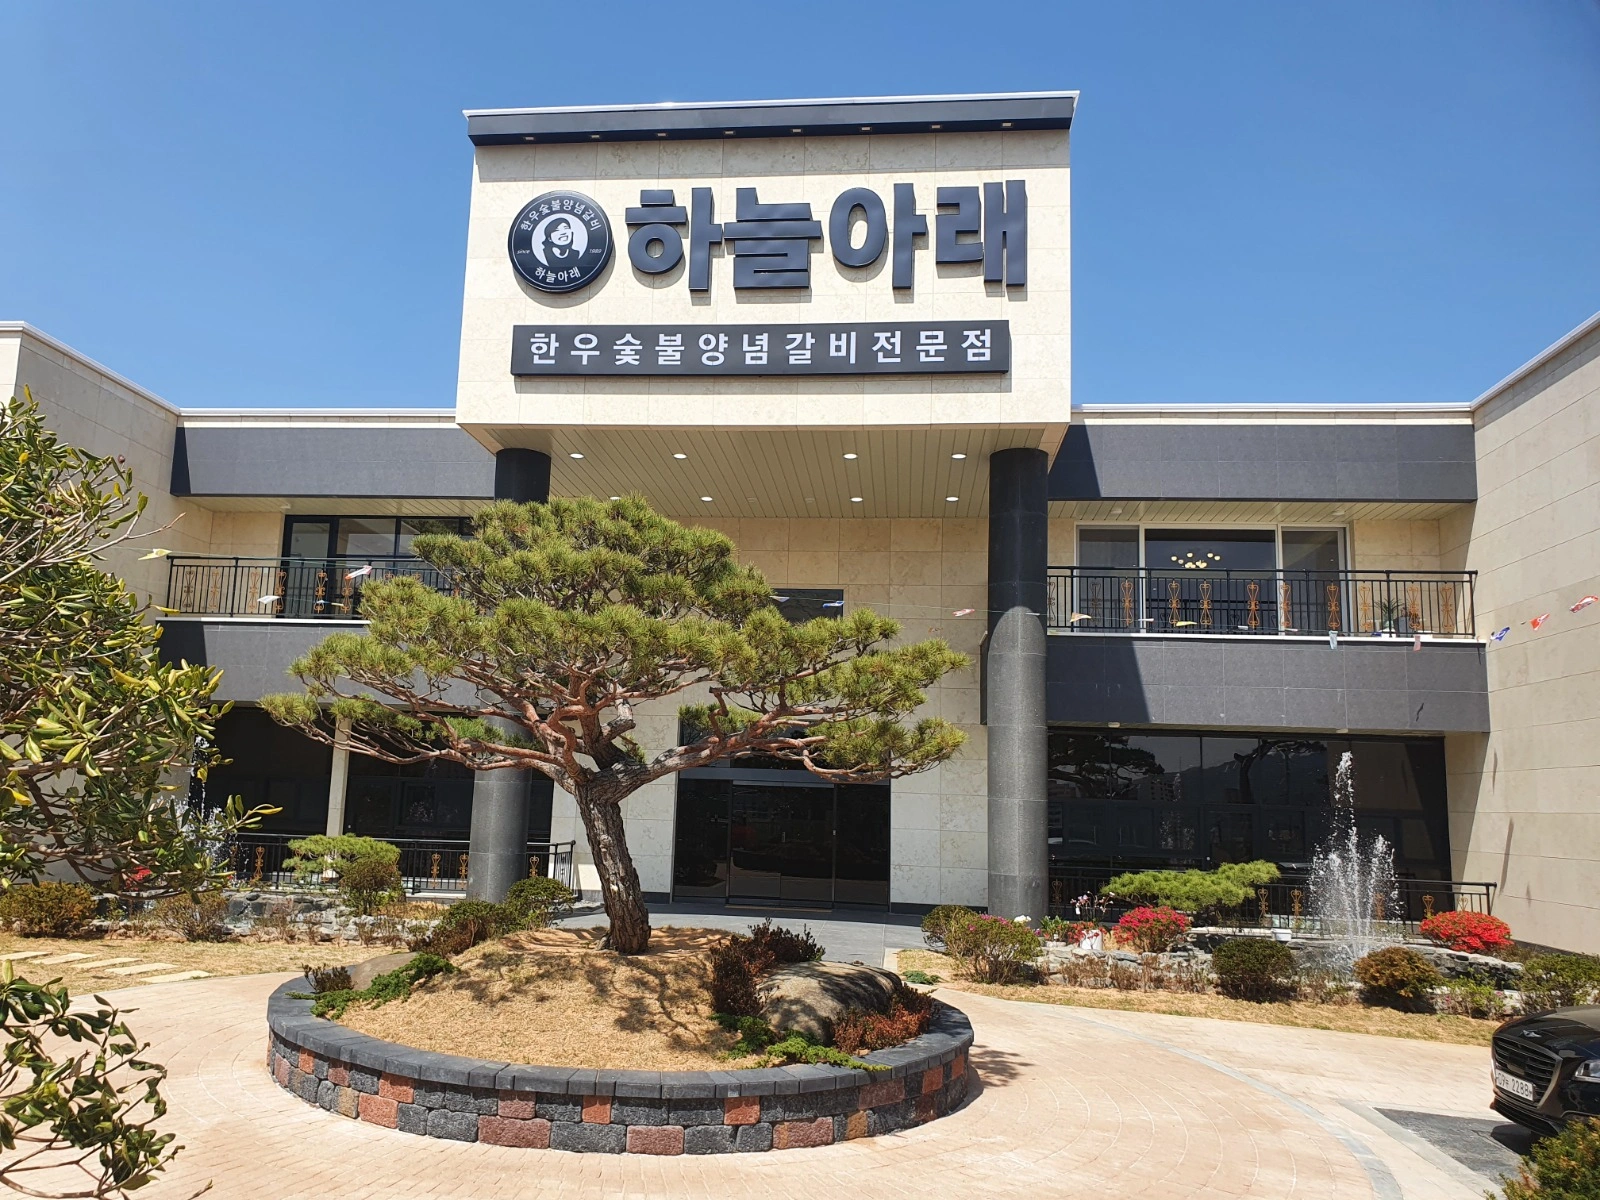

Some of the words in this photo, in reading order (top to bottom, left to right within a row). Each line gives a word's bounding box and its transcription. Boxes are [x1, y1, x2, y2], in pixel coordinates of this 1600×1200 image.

[625, 180, 1025, 291] 하늘아래
[535, 266, 581, 283] 하늘아래
[529, 328, 994, 366] 한우숯불양념갈비전문점
